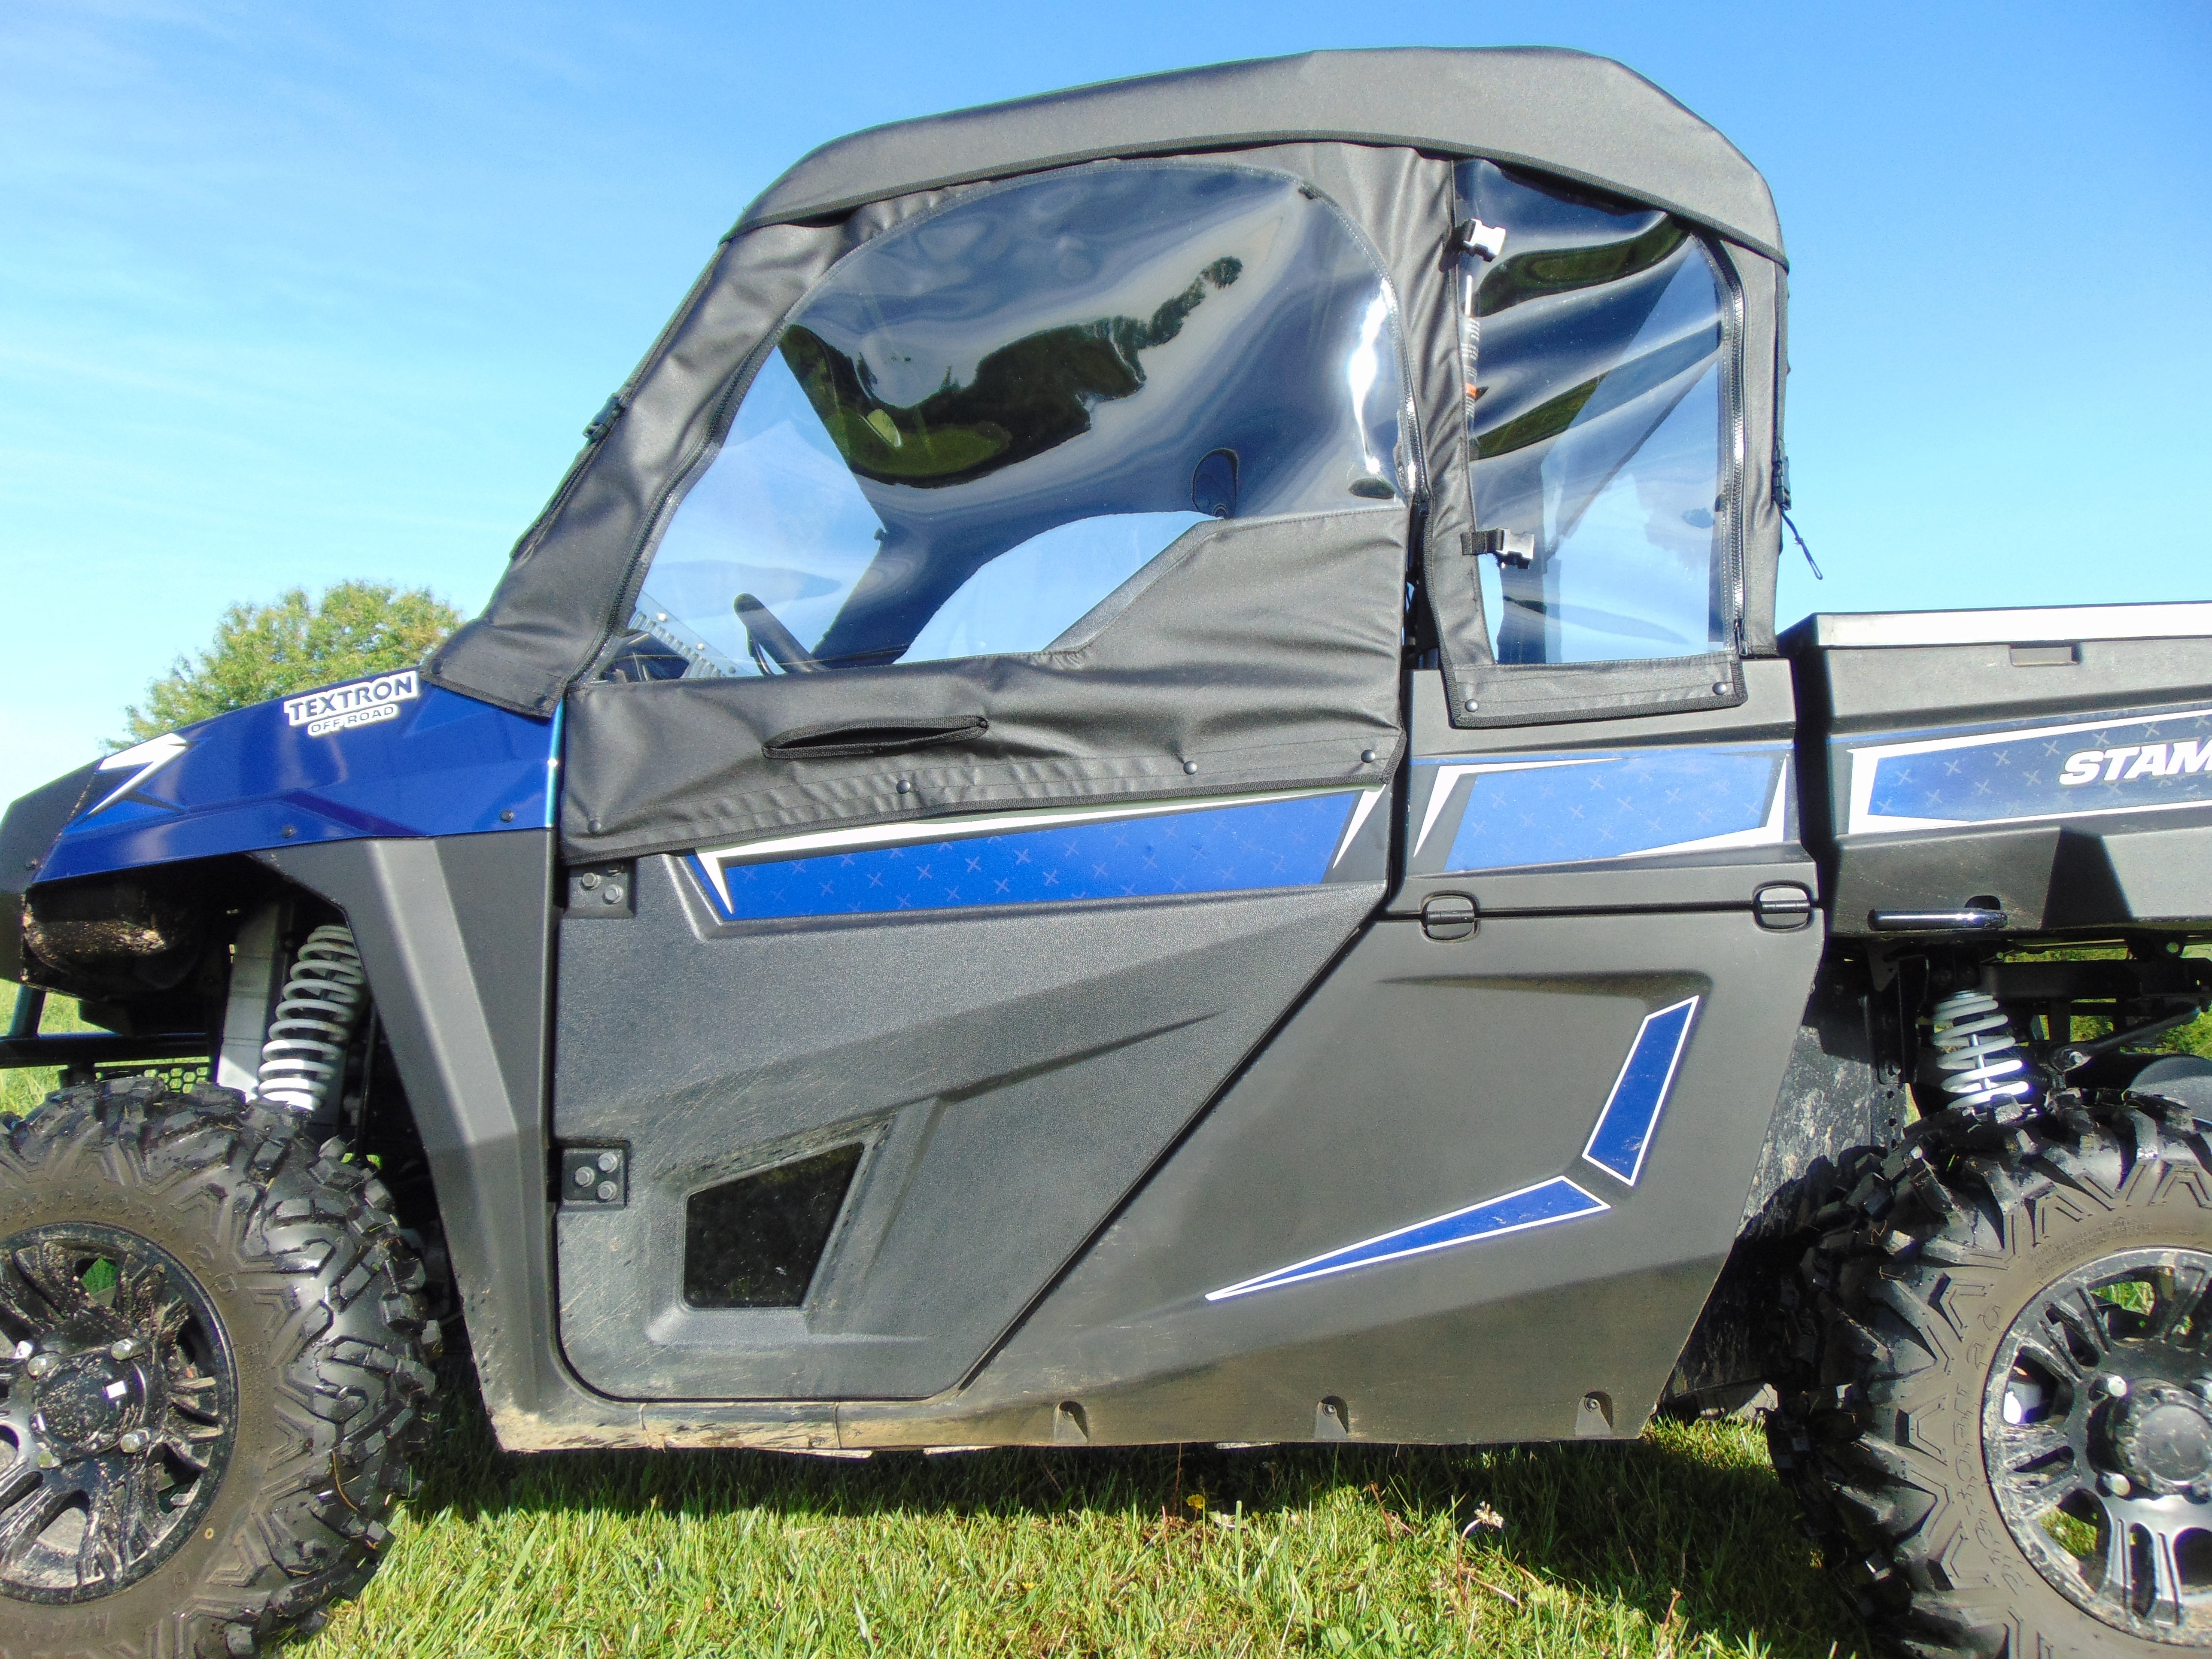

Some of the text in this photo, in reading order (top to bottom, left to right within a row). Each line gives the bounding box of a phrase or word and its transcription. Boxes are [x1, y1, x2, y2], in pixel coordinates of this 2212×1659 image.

[289, 675, 412, 721] TEXTRON
[311, 706, 394, 732] OFF ROAD
[2059, 739, 2212, 785] STAM
